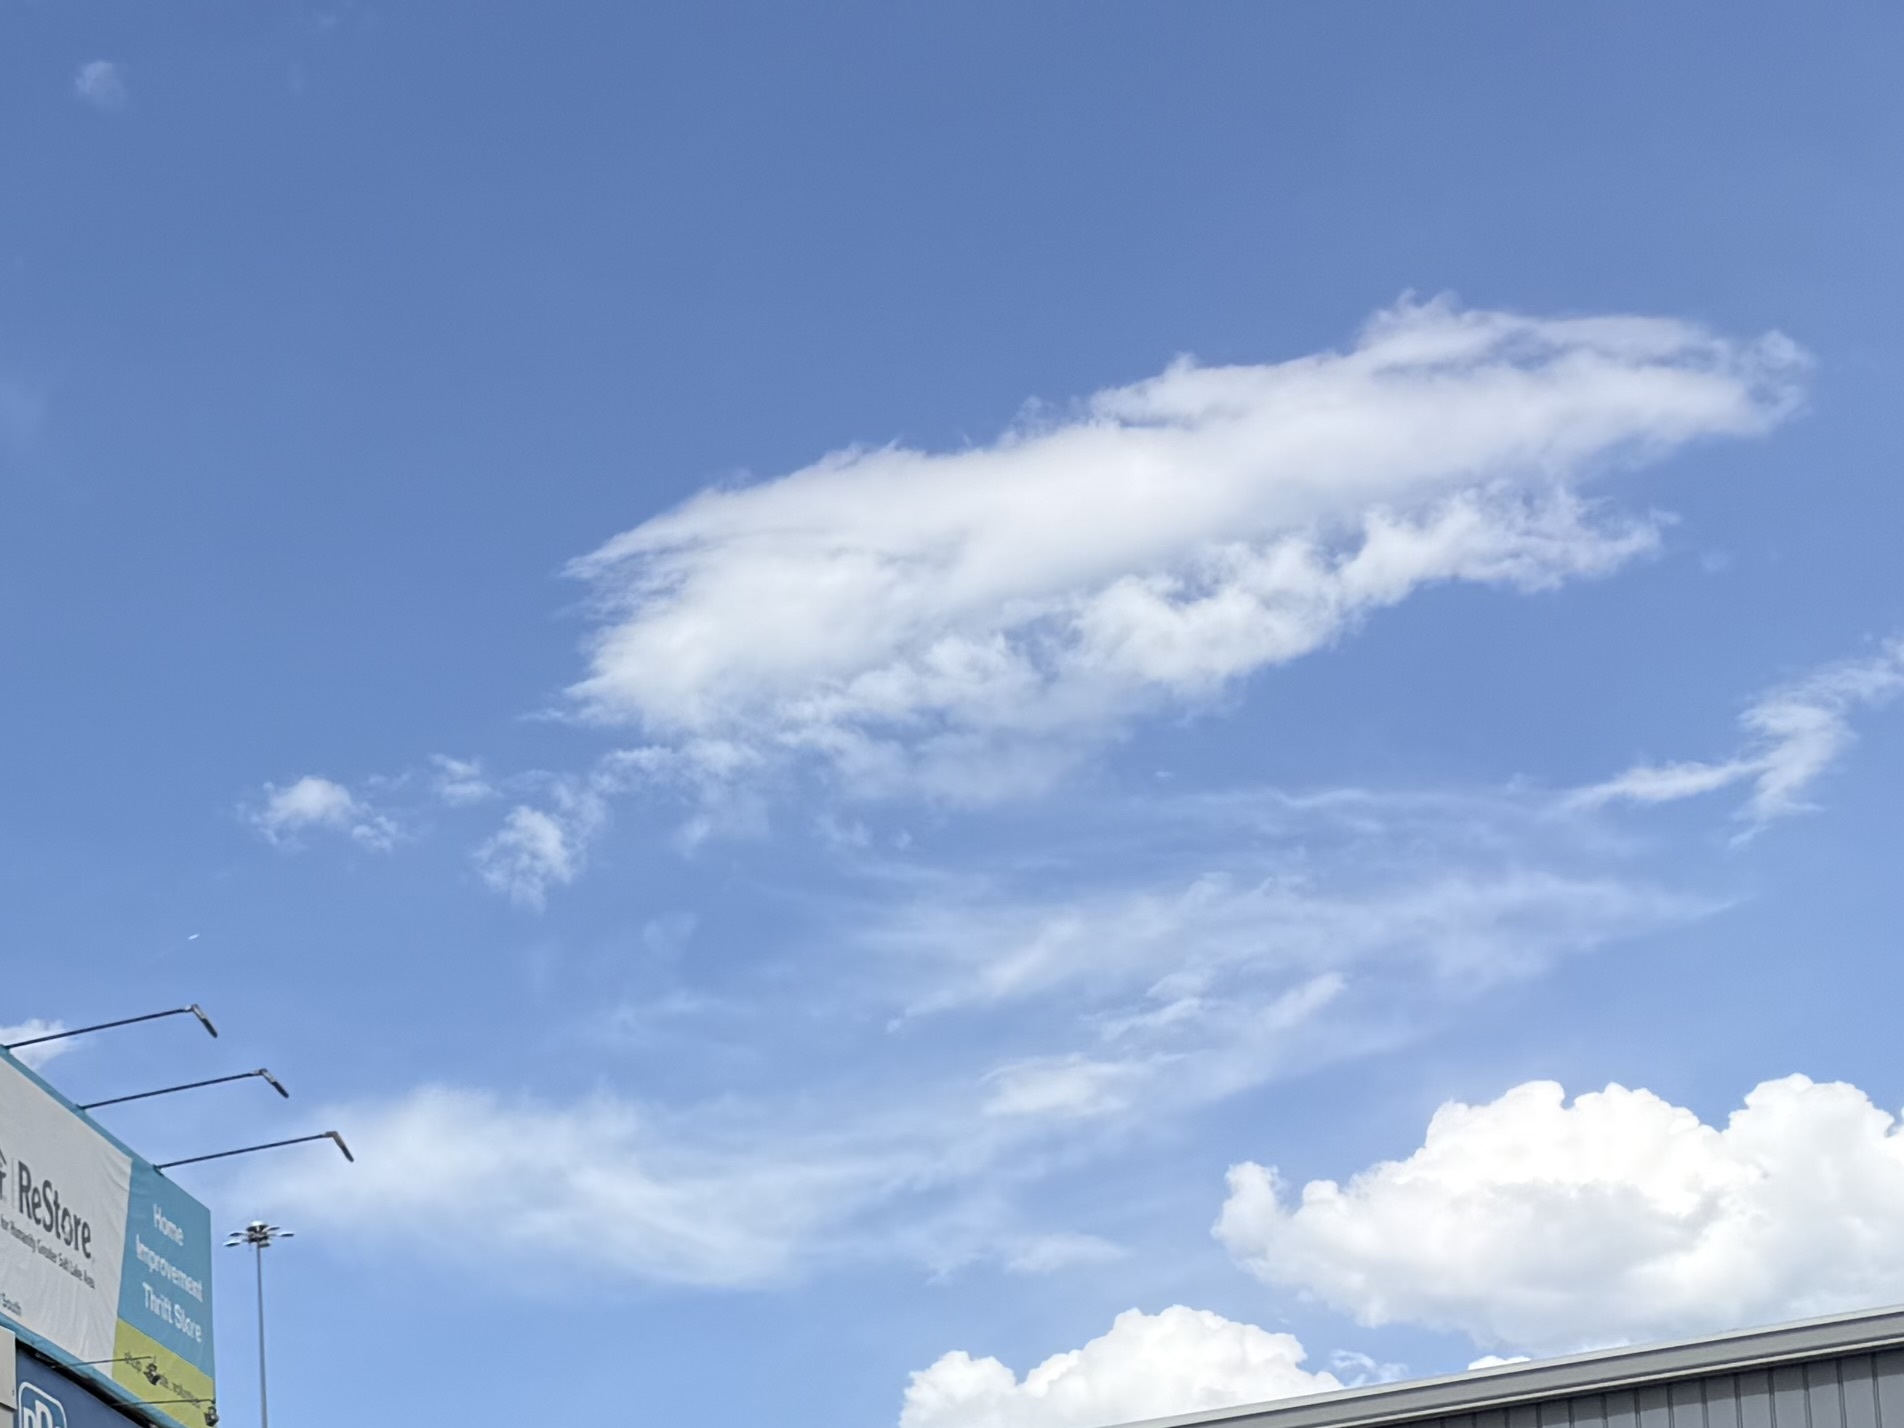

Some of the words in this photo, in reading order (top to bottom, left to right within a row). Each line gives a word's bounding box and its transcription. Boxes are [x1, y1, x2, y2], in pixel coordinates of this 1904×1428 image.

[17, 1159, 92, 1260] ReStore
[153, 1203, 184, 1247] Home
[136, 1233, 203, 1303] Improvement
[142, 1281, 173, 1325] Thrift
[173, 1303, 202, 1343] Store
